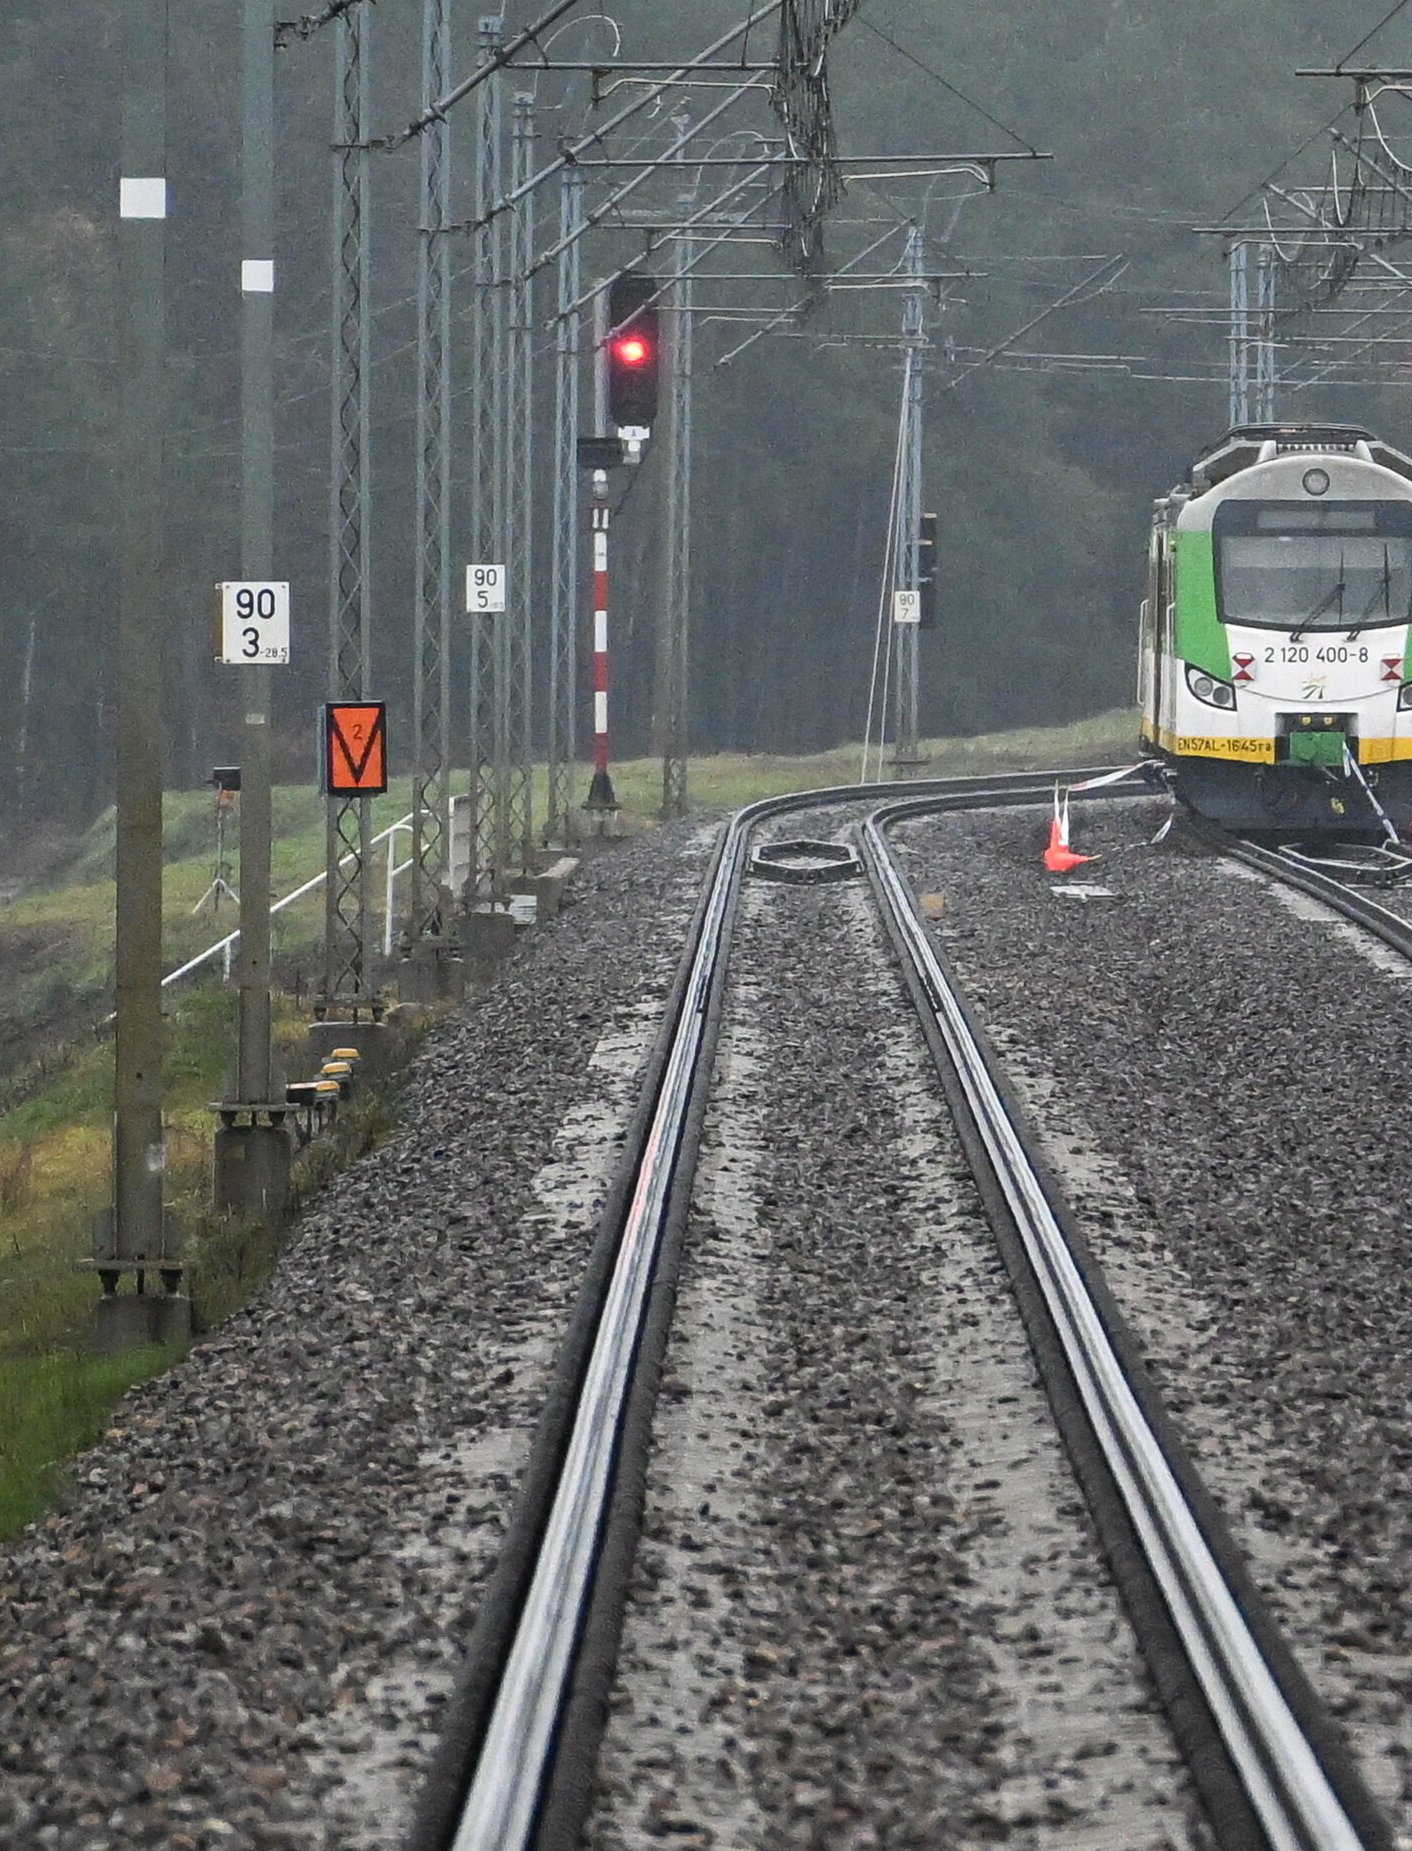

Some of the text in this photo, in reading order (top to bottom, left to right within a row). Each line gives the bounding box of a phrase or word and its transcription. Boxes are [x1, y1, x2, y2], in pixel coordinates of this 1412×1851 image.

[475, 569, 497, 586] 90
[236, 588, 276, 619] 90
[477, 590, 489, 608] 5
[901, 607, 909, 619] 7
[242, 627, 260, 658] 3
[1264, 647, 1369, 663] 2 120 400-8
[352, 724, 363, 740] 2
